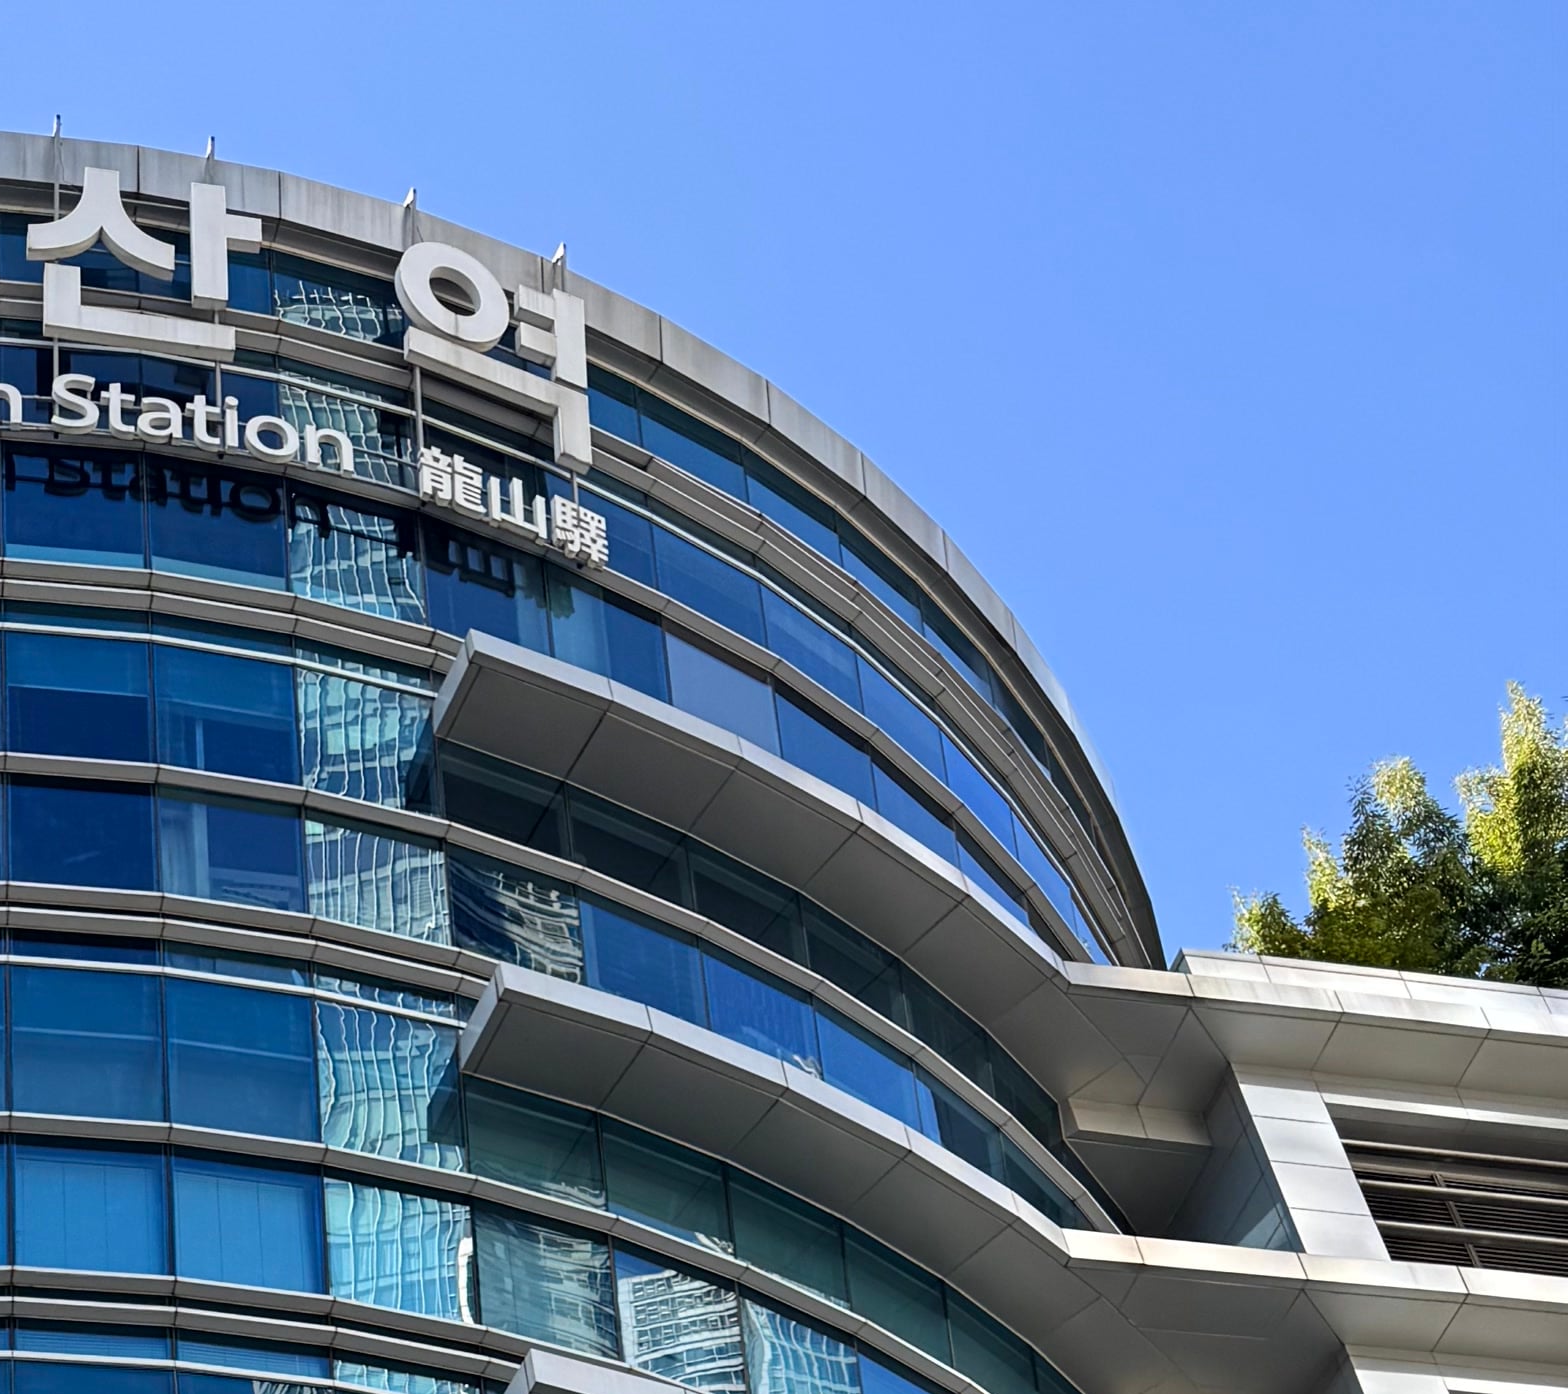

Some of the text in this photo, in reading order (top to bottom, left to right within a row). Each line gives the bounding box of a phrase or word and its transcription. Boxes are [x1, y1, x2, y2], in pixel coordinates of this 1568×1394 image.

[49, 372, 356, 474] Station
[419, 445, 610, 569] 龍山驛
